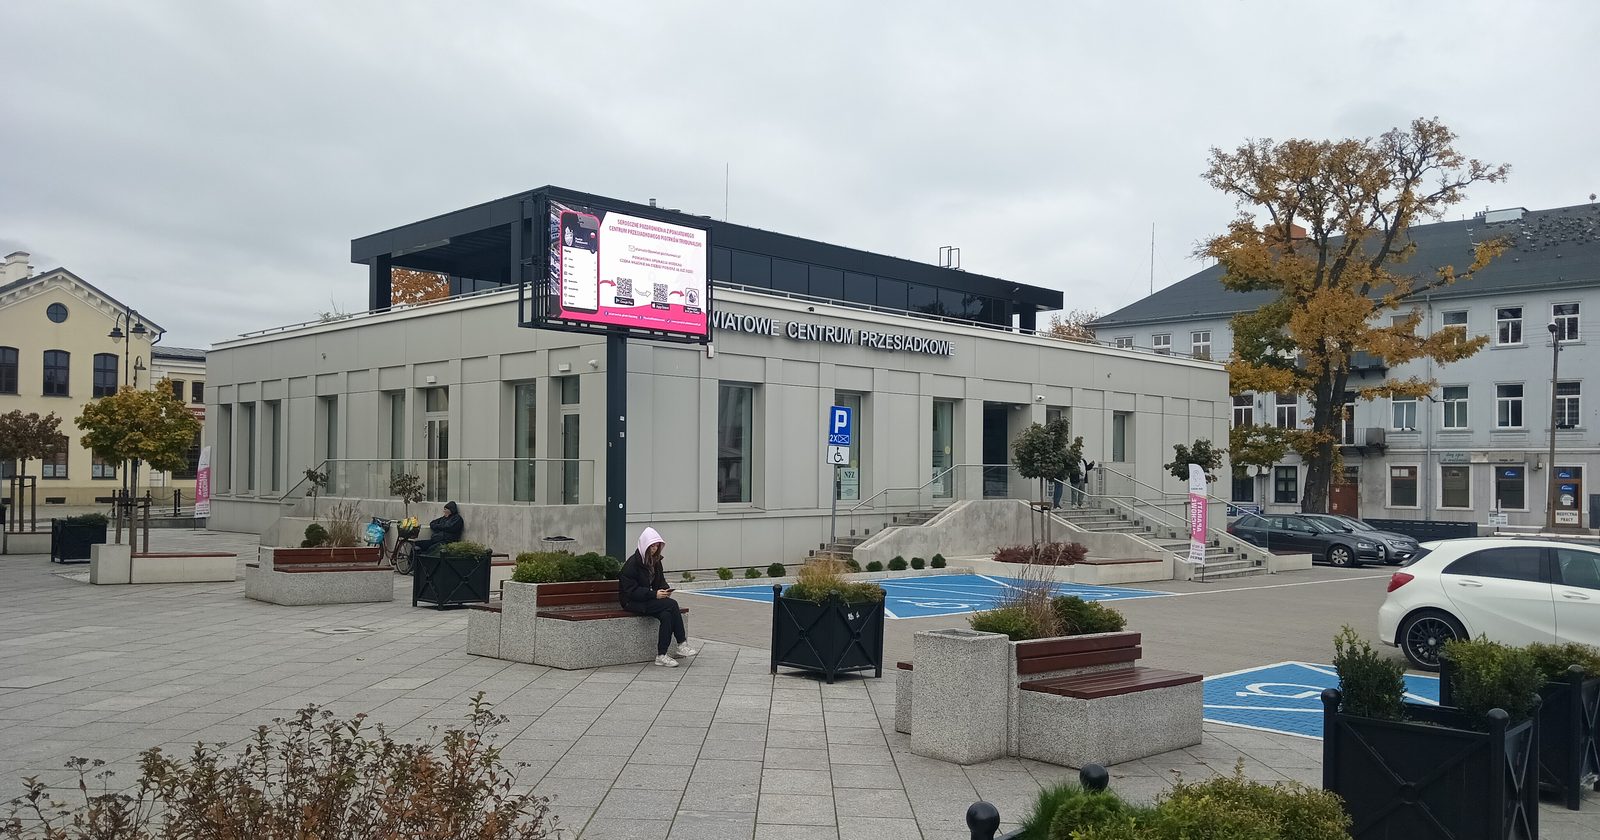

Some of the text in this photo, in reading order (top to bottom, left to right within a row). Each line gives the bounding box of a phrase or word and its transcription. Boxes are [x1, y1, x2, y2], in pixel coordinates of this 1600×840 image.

[787, 321, 854, 345] CENTRUM
[860, 331, 956, 356] PRZESIADKOWE
[834, 410, 848, 434] P
